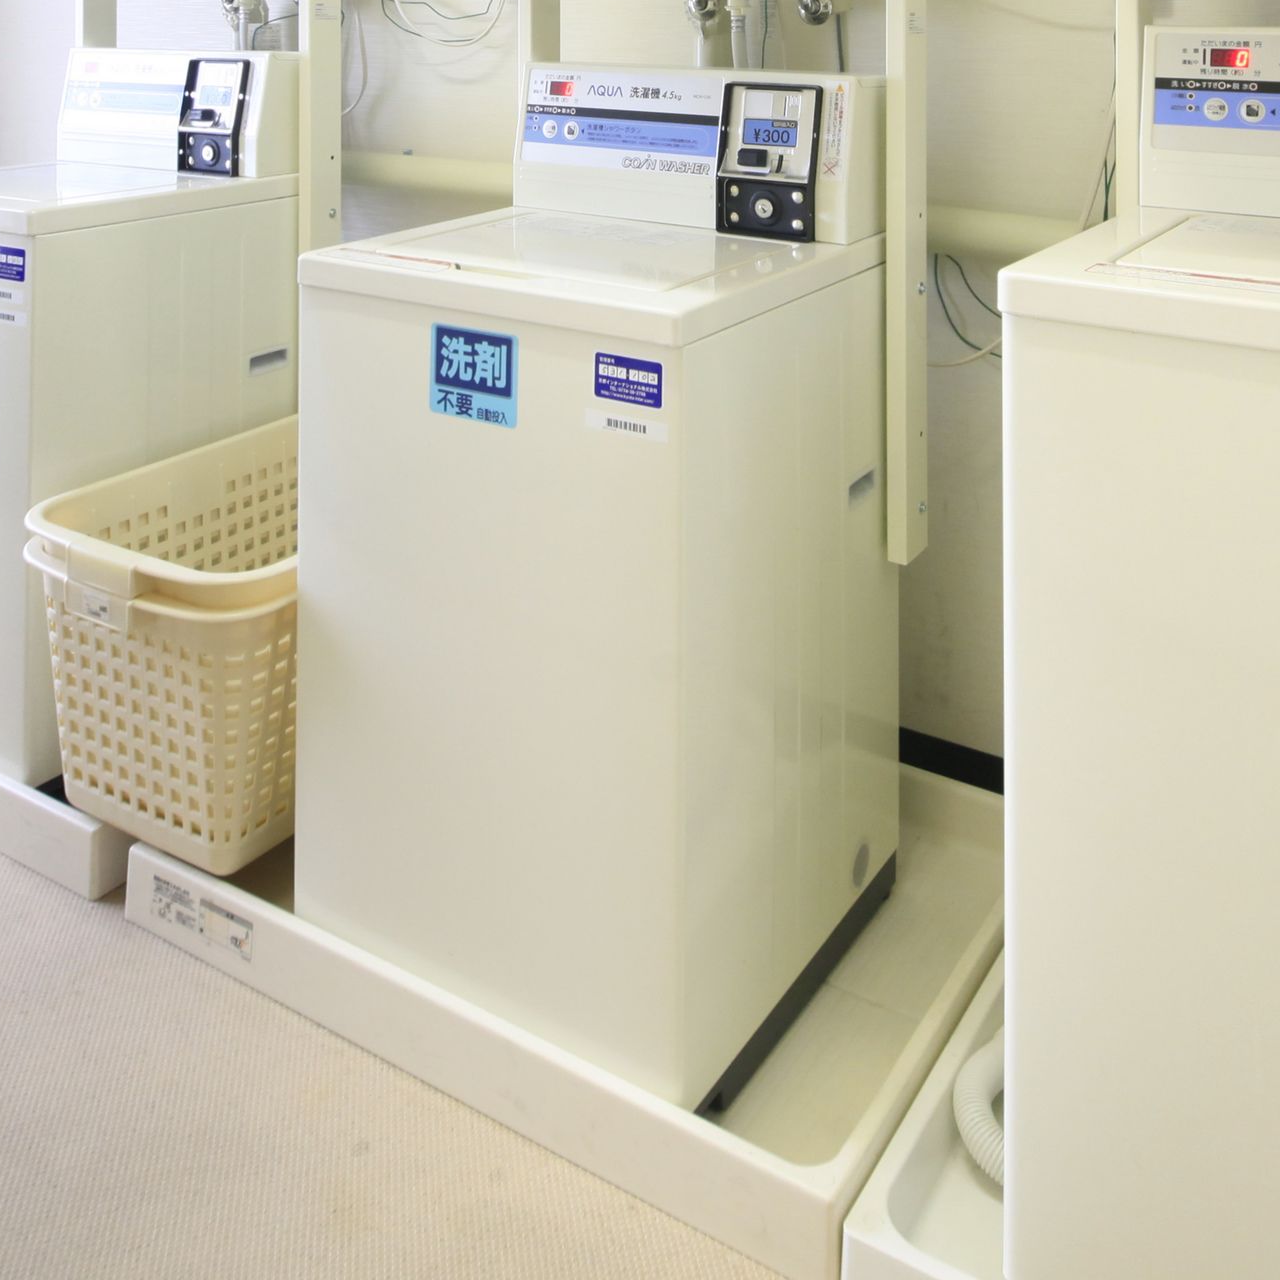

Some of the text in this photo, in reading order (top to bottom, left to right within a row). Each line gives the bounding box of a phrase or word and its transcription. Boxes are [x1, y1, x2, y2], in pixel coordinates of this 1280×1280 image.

[1235, 50, 1249, 66] 0
[587, 84, 623, 98] AQUA
[629, 86, 661, 99] 洗濯機
[753, 128, 790, 143] ¥300
[659, 160, 711, 175] WASHER
[440, 335, 507, 389] 洗剤
[436, 388, 508, 425] 不要 自動投入
